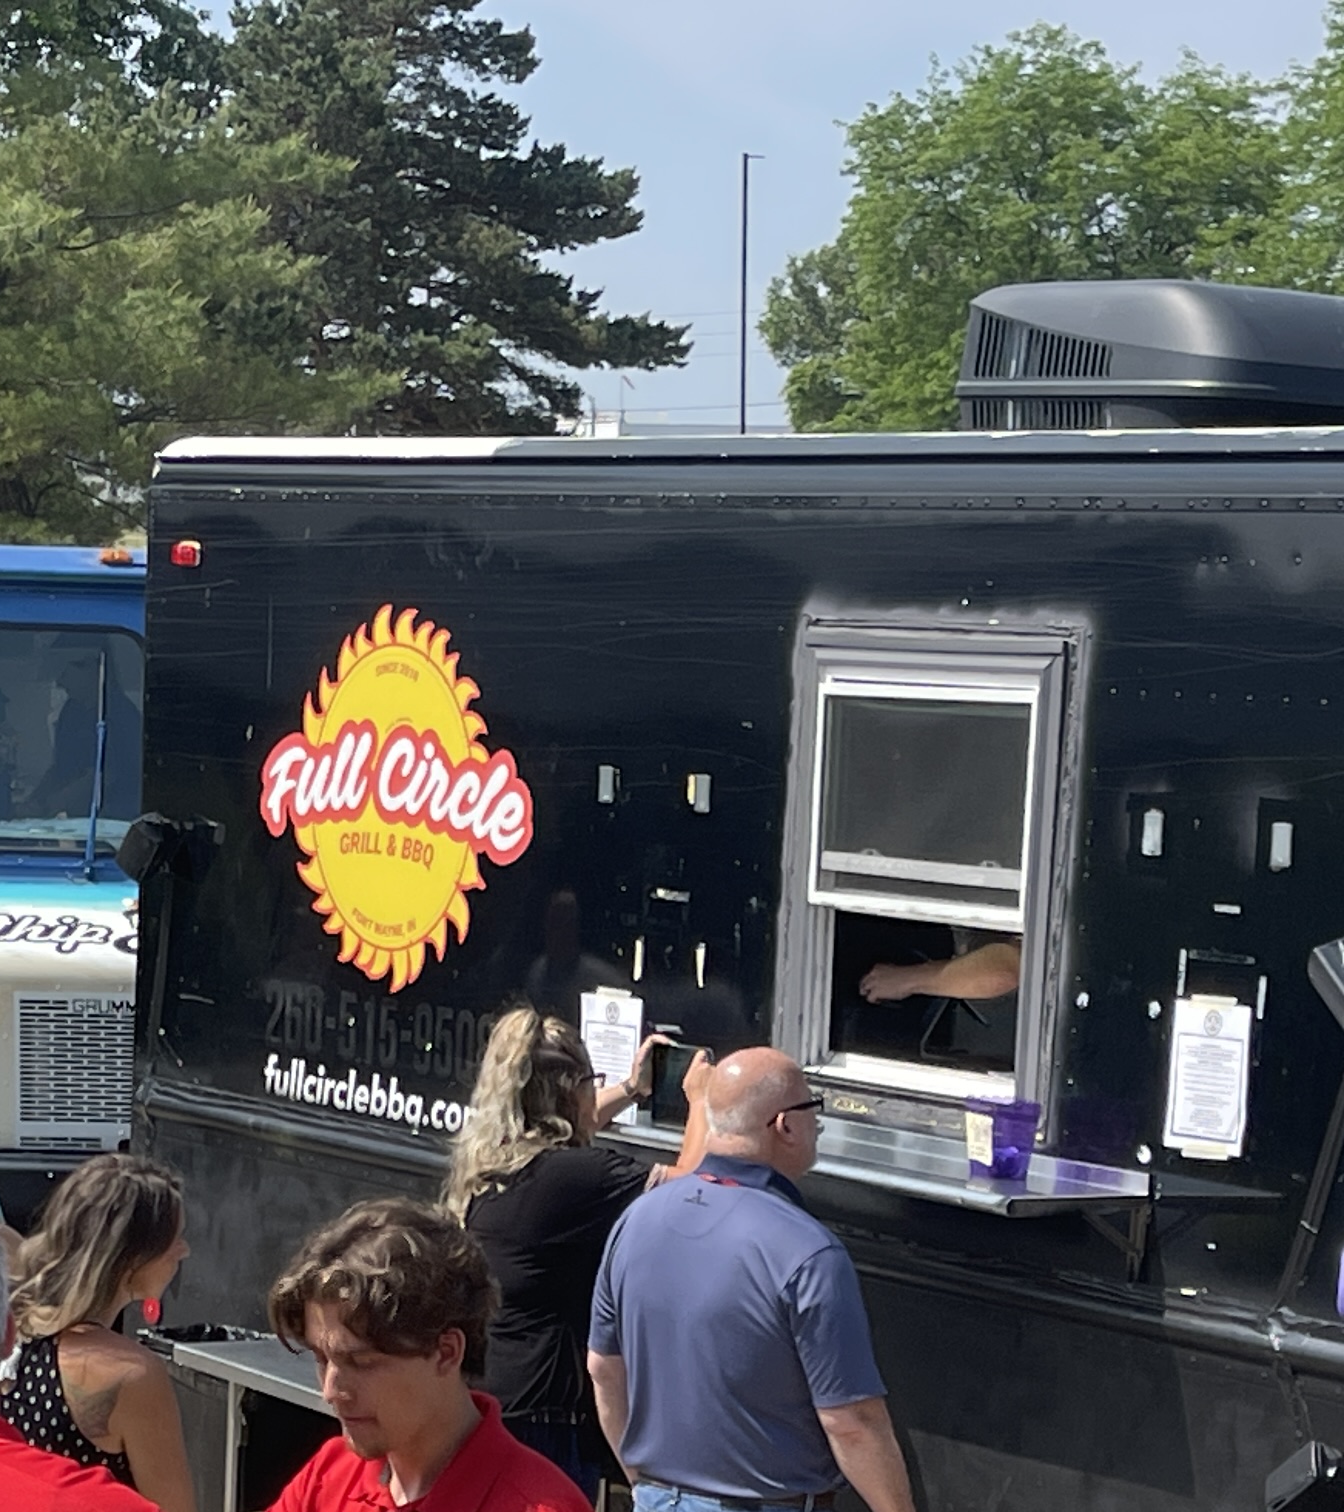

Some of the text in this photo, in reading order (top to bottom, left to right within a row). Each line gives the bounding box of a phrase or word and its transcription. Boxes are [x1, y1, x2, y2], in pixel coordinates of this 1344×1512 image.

[267, 731, 525, 852] Full Circle
[340, 832, 434, 871] GRILL & BBQ
